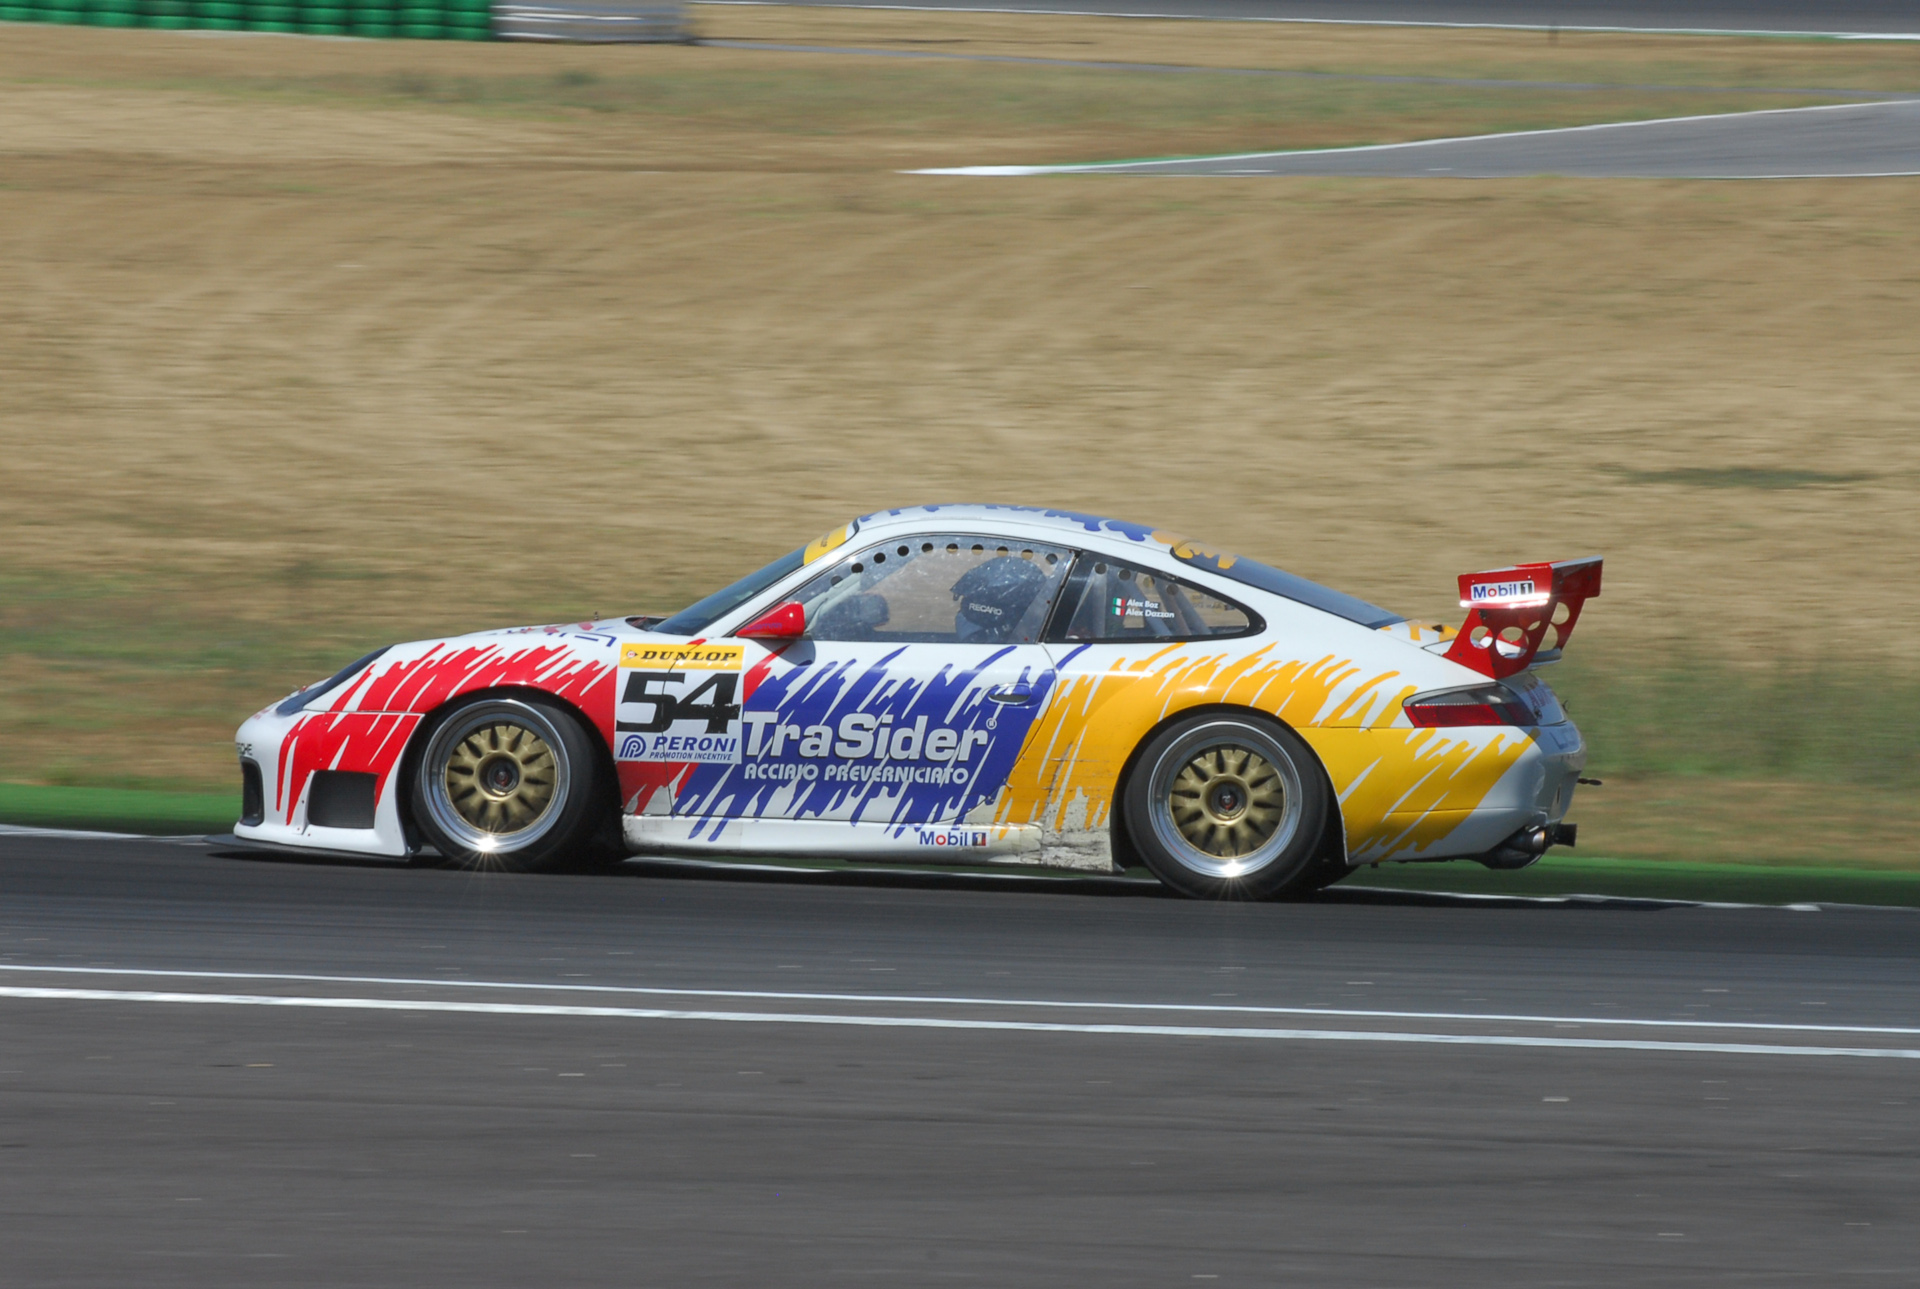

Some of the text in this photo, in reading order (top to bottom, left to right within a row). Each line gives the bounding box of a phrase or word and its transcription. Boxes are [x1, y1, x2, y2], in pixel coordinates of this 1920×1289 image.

[1473, 584, 1517, 599] Mobil
[968, 602, 1003, 616] RECARO
[1126, 599, 1144, 607] Alex
[1125, 608, 1175, 618] Alex Dazzan
[640, 650, 737, 662] DUNLOP
[615, 671, 741, 734] 54
[742, 711, 989, 762] TraSider
[652, 736, 737, 753] PERONI
[649, 751, 733, 761] PROMOTION INCENTIVE
[744, 763, 969, 785] ACCIAIO PREVERNICIATO
[920, 831, 985, 846] Mobil 1
